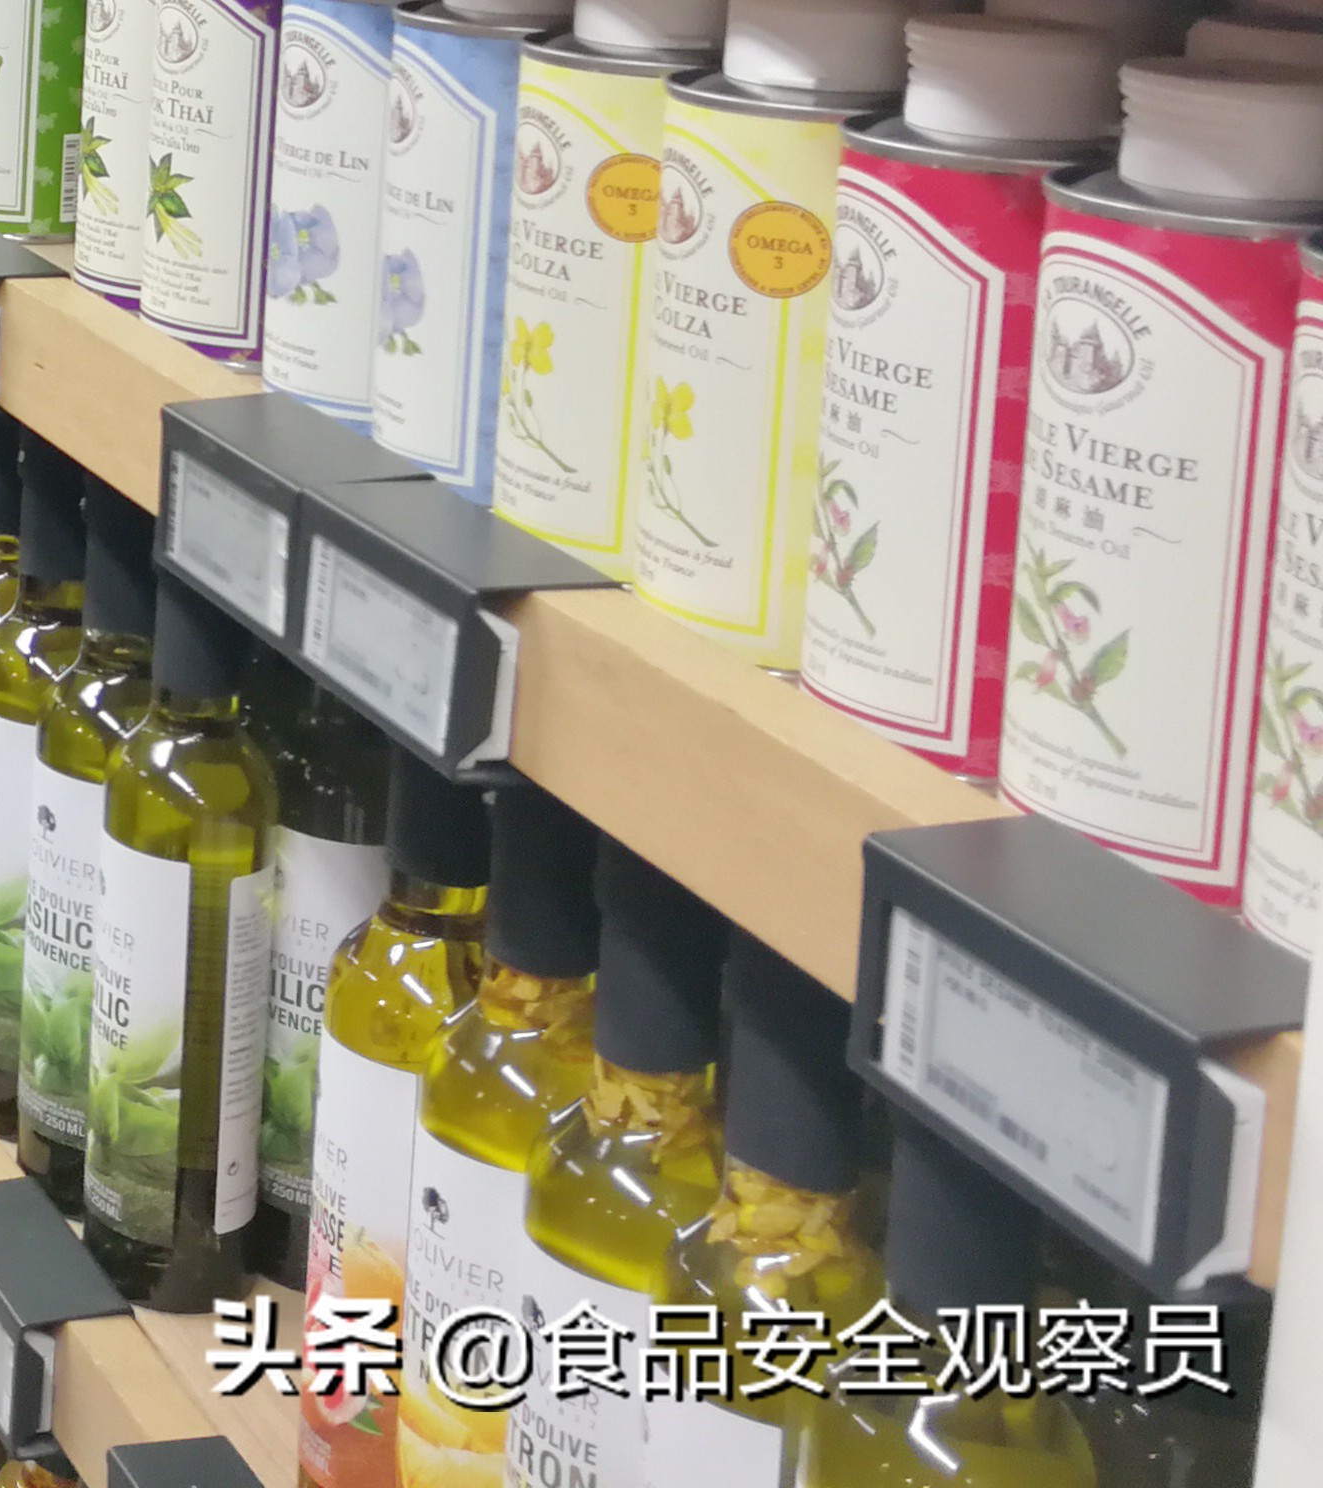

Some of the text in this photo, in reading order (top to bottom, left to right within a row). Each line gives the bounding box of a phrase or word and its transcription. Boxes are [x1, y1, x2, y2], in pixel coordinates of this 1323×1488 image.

[92, 64, 128, 90] THAÏ
[171, 79, 203, 100] POUR
[167, 97, 214, 125] THAÏ
[339, 150, 370, 171] LIN
[425, 191, 455, 214] LIN
[522, 218, 604, 260] VIERGE
[747, 234, 813, 256] OMEGA
[773, 256, 783, 270] 3
[662, 271, 747, 317] VIERGE
[1052, 275, 1153, 341] TOURANGELLE
[837, 336, 933, 389] VIERGE
[1066, 421, 1200, 483] VIERGE
[1042, 449, 1155, 510] SESAME
[39, 885, 94, 921] D'OLIVE
